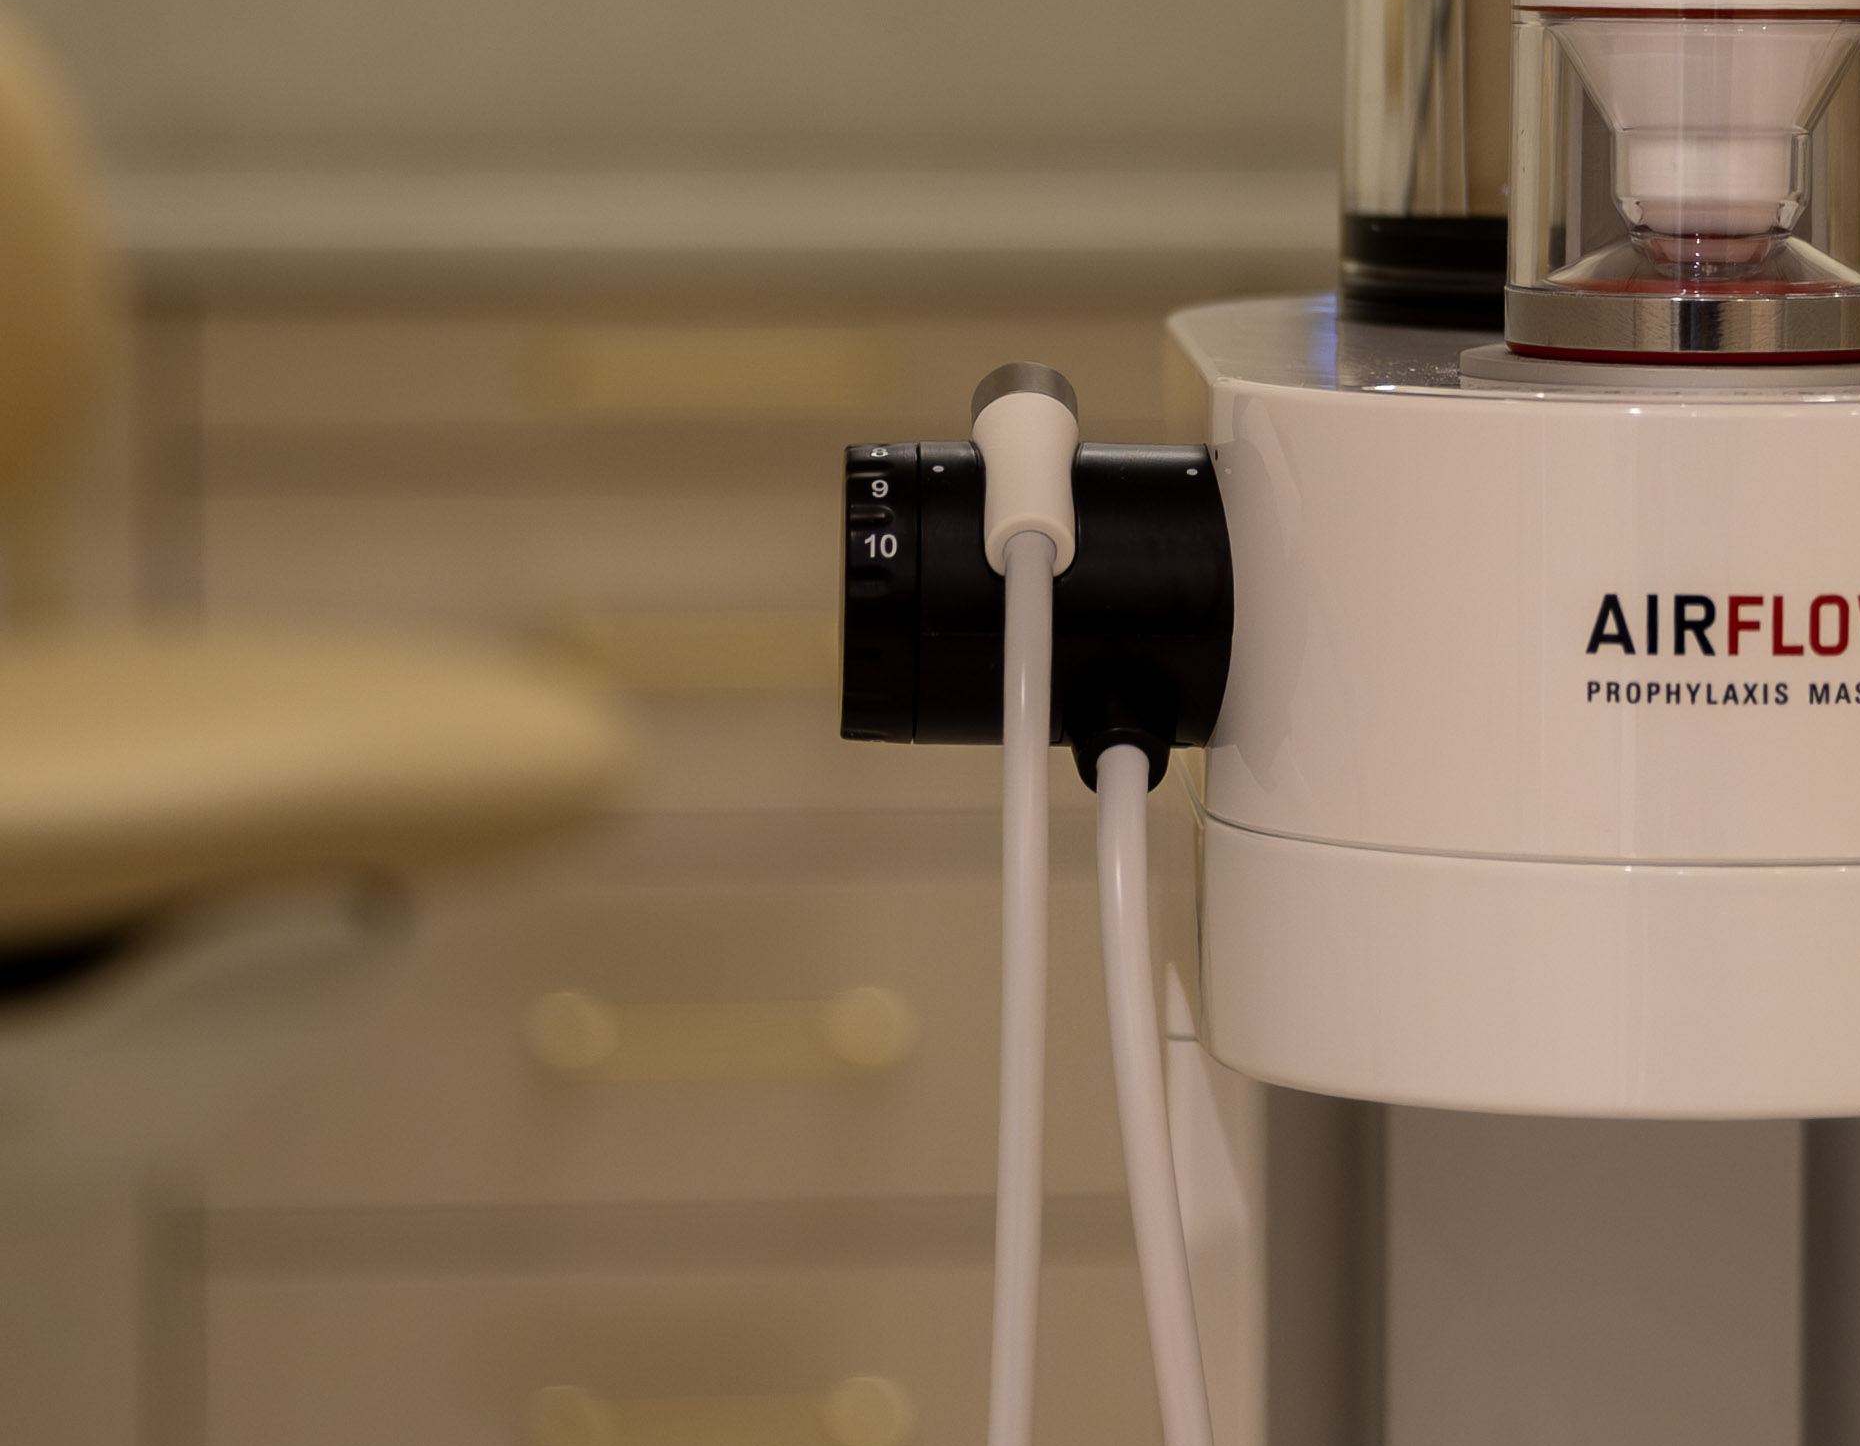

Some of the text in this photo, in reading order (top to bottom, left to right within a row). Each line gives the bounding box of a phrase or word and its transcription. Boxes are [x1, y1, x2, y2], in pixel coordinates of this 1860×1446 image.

[871, 480, 889, 498] 9
[864, 534, 897, 558] 10
[1587, 681, 1789, 705] PROPHYLAXIS
